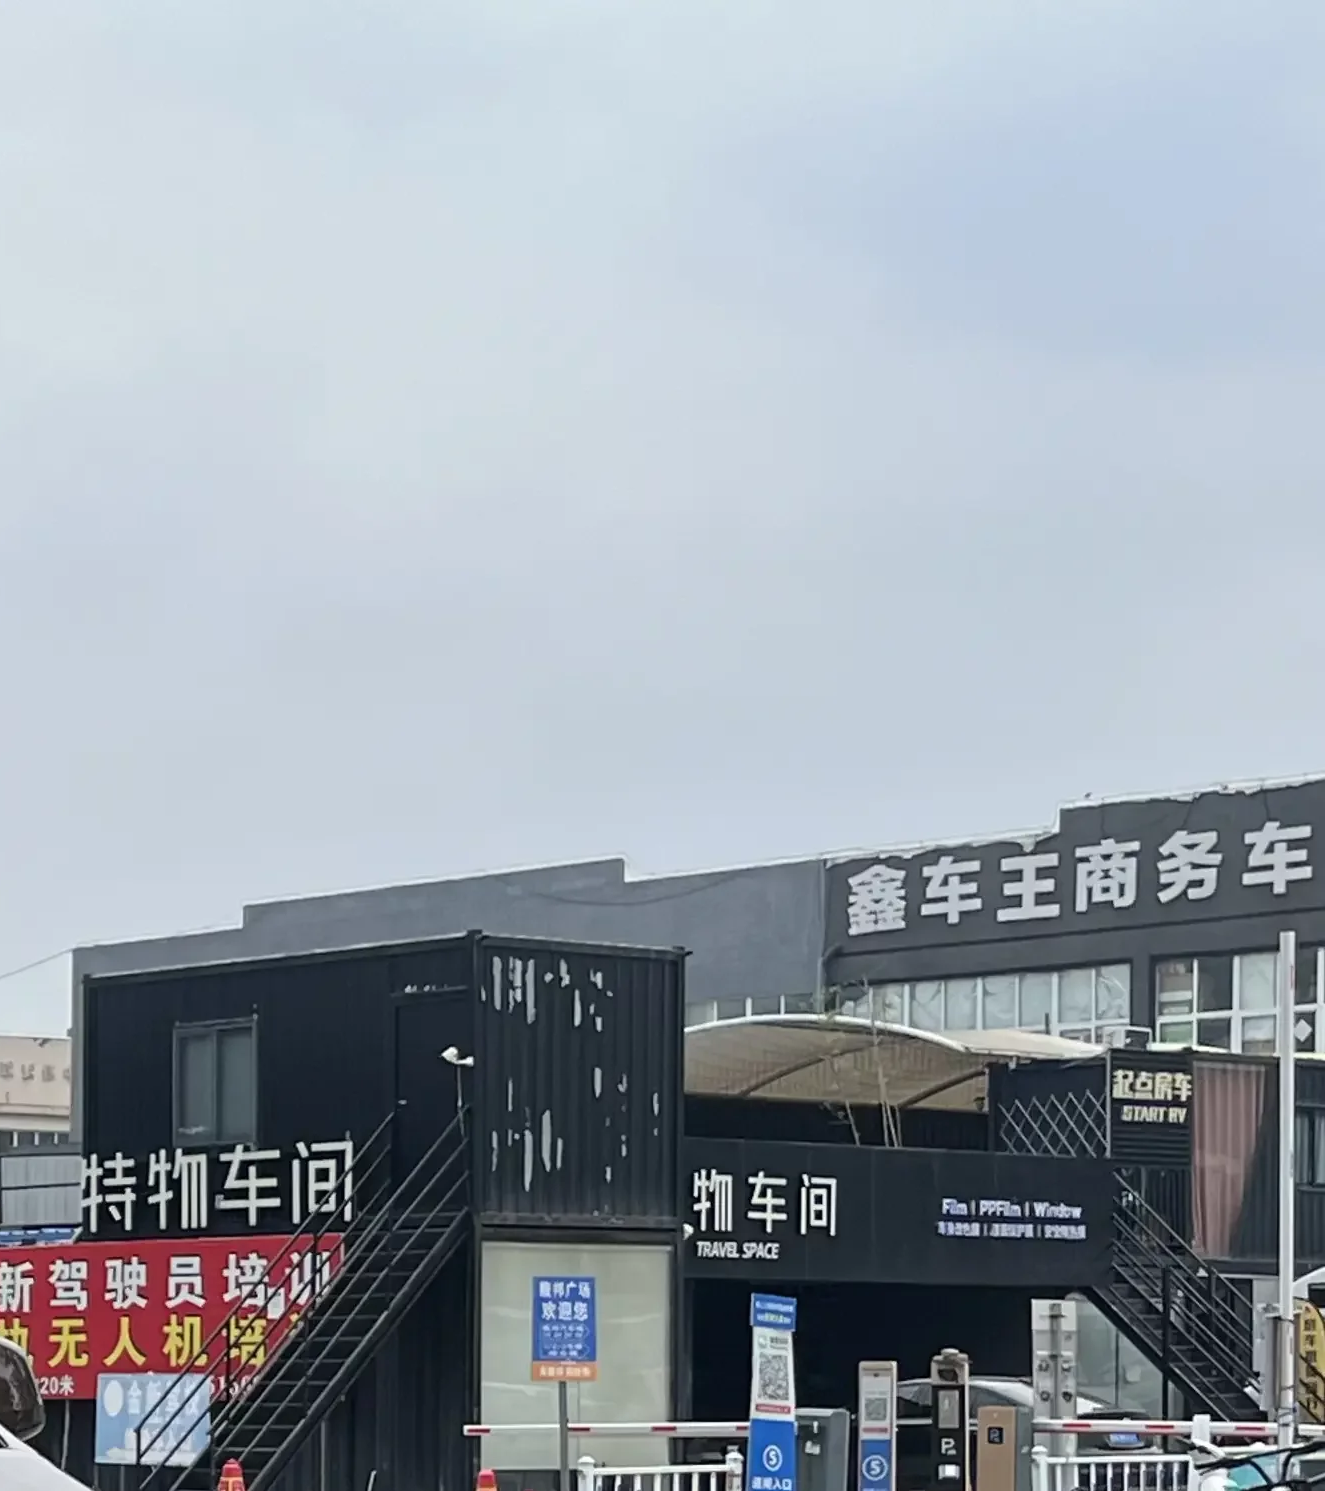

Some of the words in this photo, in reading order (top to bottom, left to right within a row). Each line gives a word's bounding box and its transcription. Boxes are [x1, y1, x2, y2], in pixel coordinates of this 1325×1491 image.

[848, 821, 1313, 936] 鑫车王商务车
[1112, 1069, 1192, 1102] 起点房车
[1122, 1105, 1167, 1122] START
[1169, 1107, 1187, 1123] RV
[81, 1142, 353, 1233] 特物车间
[693, 1169, 837, 1236] 物车间
[942, 1198, 968, 1215] Film
[1033, 1202, 1082, 1219] Window
[696, 1241, 739, 1258] TRAVEL
[742, 1242, 780, 1259] SPACE
[541, 1301, 588, 1320] 欢迎您
[35, 1374, 74, 1396] 20米
